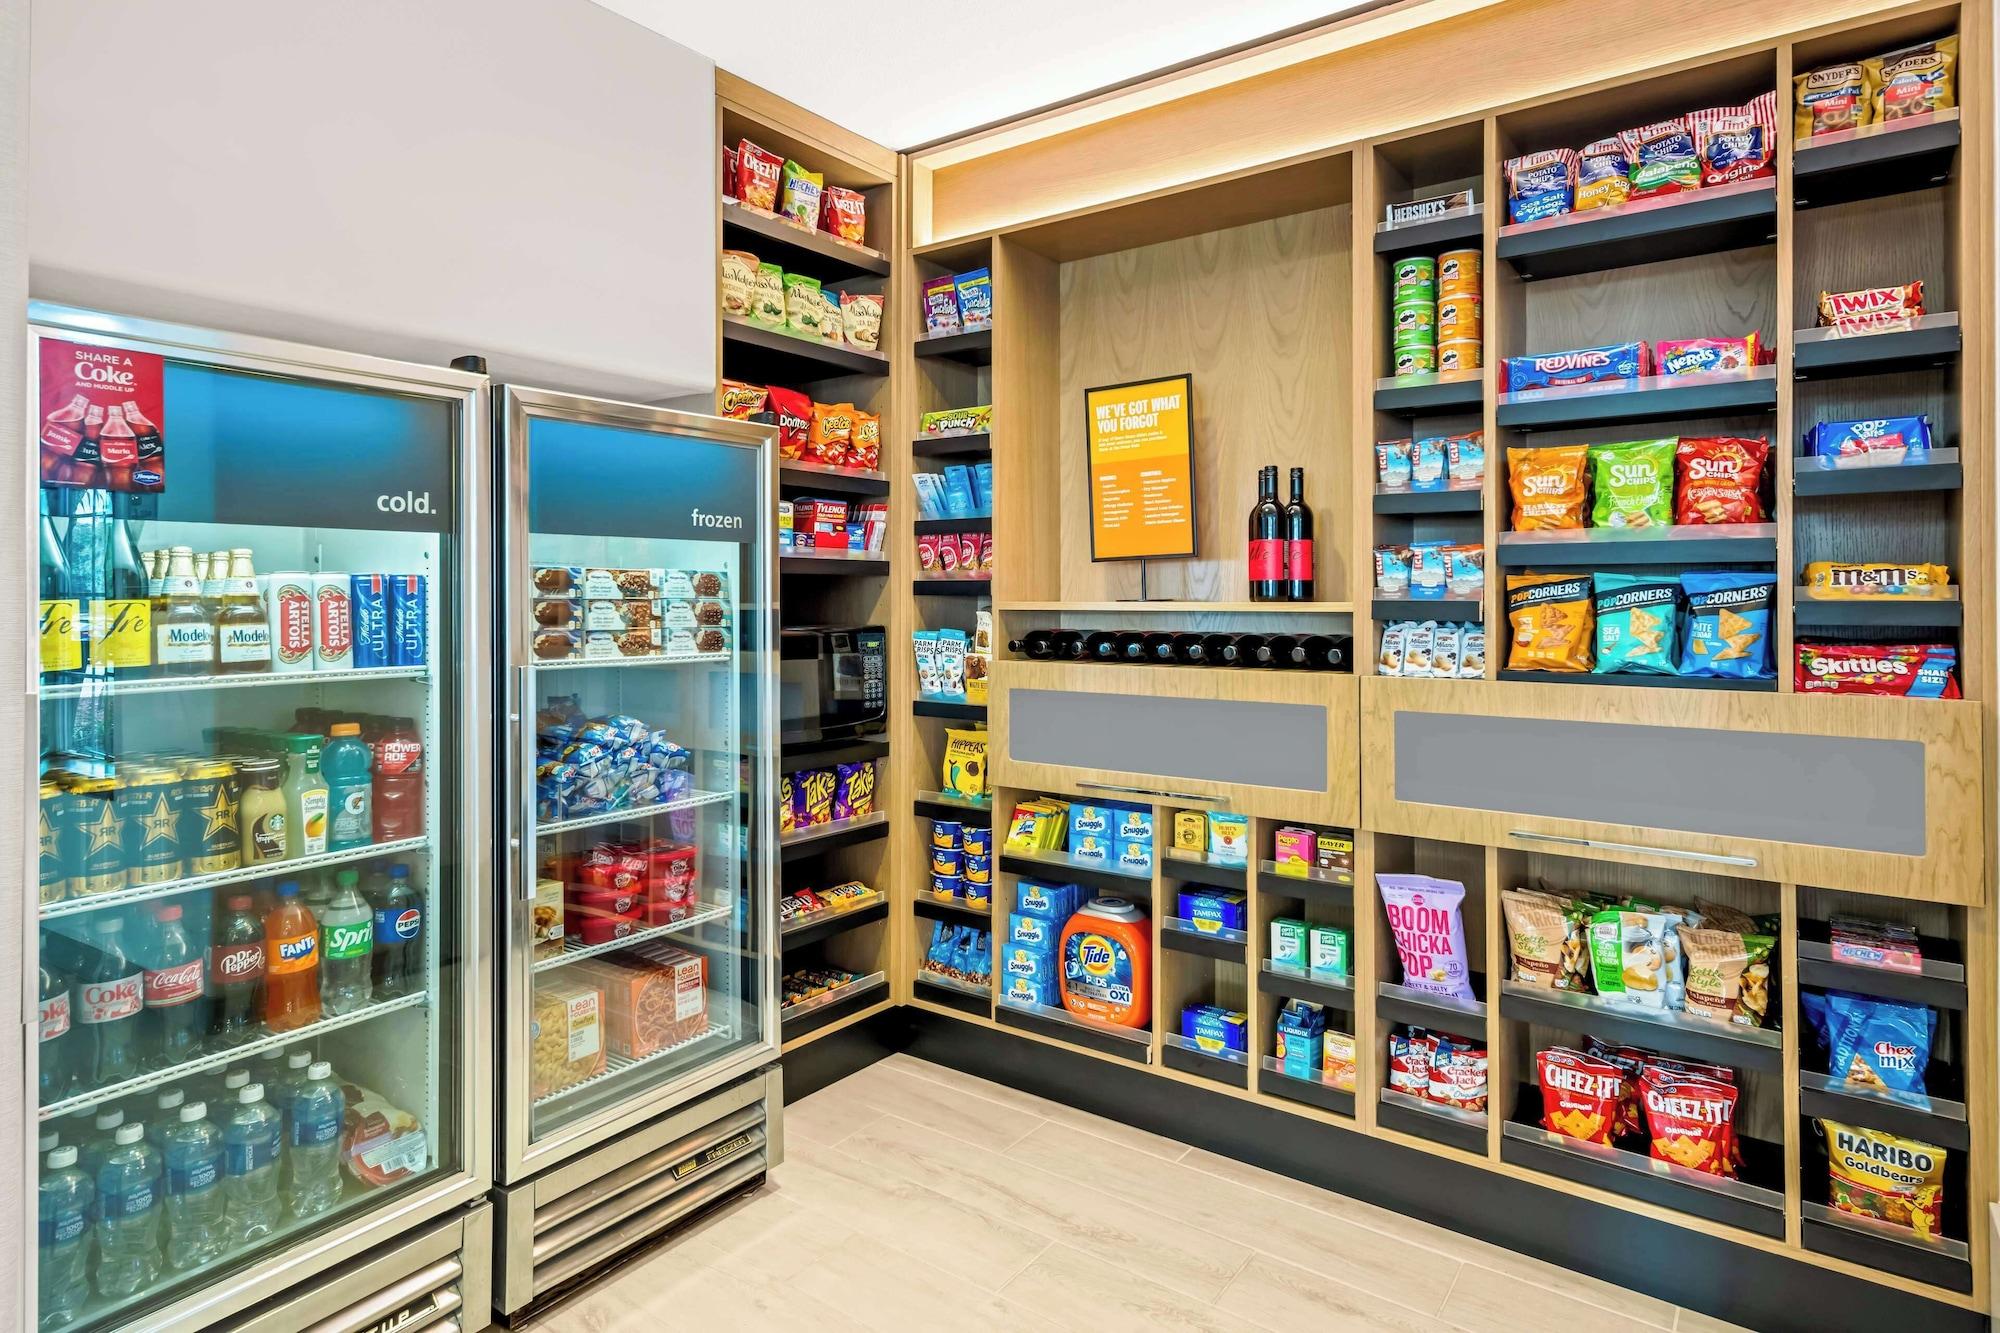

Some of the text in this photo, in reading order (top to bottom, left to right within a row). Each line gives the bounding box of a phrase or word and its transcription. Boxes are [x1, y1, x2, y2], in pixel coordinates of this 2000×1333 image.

[1884, 56, 1936, 77] SNYDER'S
[1812, 66, 1860, 83] SNYDER'S
[1896, 86, 1921, 95] Mini
[1825, 98, 1847, 107] Mini
[1650, 124, 1681, 137] Tim's
[1722, 118, 1751, 131] Tim's
[1650, 135, 1682, 152] POTATO
[1719, 134, 1753, 143] POTATO
[1722, 141, 1750, 150] CHIPS
[1594, 141, 1621, 153] Tim's
[1655, 143, 1680, 156] CHIPS
[1590, 155, 1621, 163] POTATO
[1528, 166, 1558, 178] POTATO
[1530, 174, 1555, 184] CHIPS
[1579, 184, 1611, 199] Honey
[1520, 200, 1540, 211] Sea
[1542, 191, 1565, 202] Salt
[1394, 199, 1446, 223] HERSHEY'S
[1827, 288, 1898, 318] TWIX
[1832, 310, 1905, 338] TWIX
[75, 350, 133, 367] SHARE A
[74, 361, 136, 386] Coke
[75, 382, 92, 390] AND
[93, 383, 123, 392] HUDDLE
[1096, 395, 1181, 419] WE'VE GOT WHAT
[822, 415, 851, 438] Cheetos
[940, 417, 975, 432] PUNCH
[1097, 412, 1160, 434] YOU FORGOT
[1610, 464, 1658, 487] Sun
[1689, 457, 1742, 480] Sun
[1706, 471, 1740, 479] CHIPS
[1523, 475, 1565, 497] Sun
[1626, 476, 1657, 485] CHIPS
[1536, 487, 1565, 495] CHIPS
[377, 491, 437, 515] cold.
[817, 503, 847, 514] TYLENOL
[691, 508, 743, 530] frozen
[1511, 582, 1581, 604] POPCORNERS
[1597, 587, 1672, 609] POPCORNERS
[98, 602, 149, 645] Tre
[288, 600, 300, 649] ARTOIS
[301, 600, 309, 648] STELLA
[328, 600, 340, 648] ARTOIS
[340, 600, 349, 647] STELLA
[371, 598, 384, 651] ULTRA
[405, 598, 418, 650] ULTRA
[1603, 627, 1620, 635] SEA
[914, 640, 933, 648] PARM
[942, 640, 961, 648] PARM
[1603, 634, 1620, 642] SALT
[941, 645, 962, 655] CRISPS
[1811, 656, 1909, 677] Skittles
[1920, 676, 1944, 685] SIZE
[384, 742, 421, 753] POWER
[951, 738, 986, 753] HIPPEAS
[384, 752, 407, 762] ADE
[846, 765, 874, 803] Takis
[802, 773, 836, 813] Takis
[1078, 819, 1102, 830] Snuggle
[1123, 826, 1149, 836] Snuggle
[1320, 840, 1345, 848] BAYER
[1025, 899, 1046, 909] Snuggle
[1192, 909, 1222, 919] TAMPAX
[1387, 904, 1450, 935] BOOM
[1017, 930, 1040, 941] Snuggle
[1394, 929, 1453, 955] CHICKA
[236, 949, 252, 962] Dr
[1083, 946, 1110, 965] Tide
[1398, 947, 1433, 978] POP
[224, 953, 260, 975] Pepper
[677, 962, 700, 977] Lean
[1010, 962, 1034, 973] Snuggle
[85, 982, 138, 1005] Coke
[1011, 991, 1035, 1002] Snuggle
[1110, 990, 1130, 1002] OXI
[570, 998, 596, 1012] Lean
[1195, 1027, 1225, 1039] TAMPAX
[1283, 1026, 1302, 1036] LIQUID
[1875, 1042, 1916, 1056] Chex
[1879, 1053, 1916, 1070] mix
[1447, 1066, 1487, 1078] Cracker
[1453, 1075, 1477, 1085] Jack
[1545, 1063, 1614, 1100] CHEEZ-IT
[1647, 1090, 1724, 1126] CHEEZ-IT
[1837, 1131, 1935, 1172] HARIBO
[1844, 1156, 1925, 1185] Goldbears
